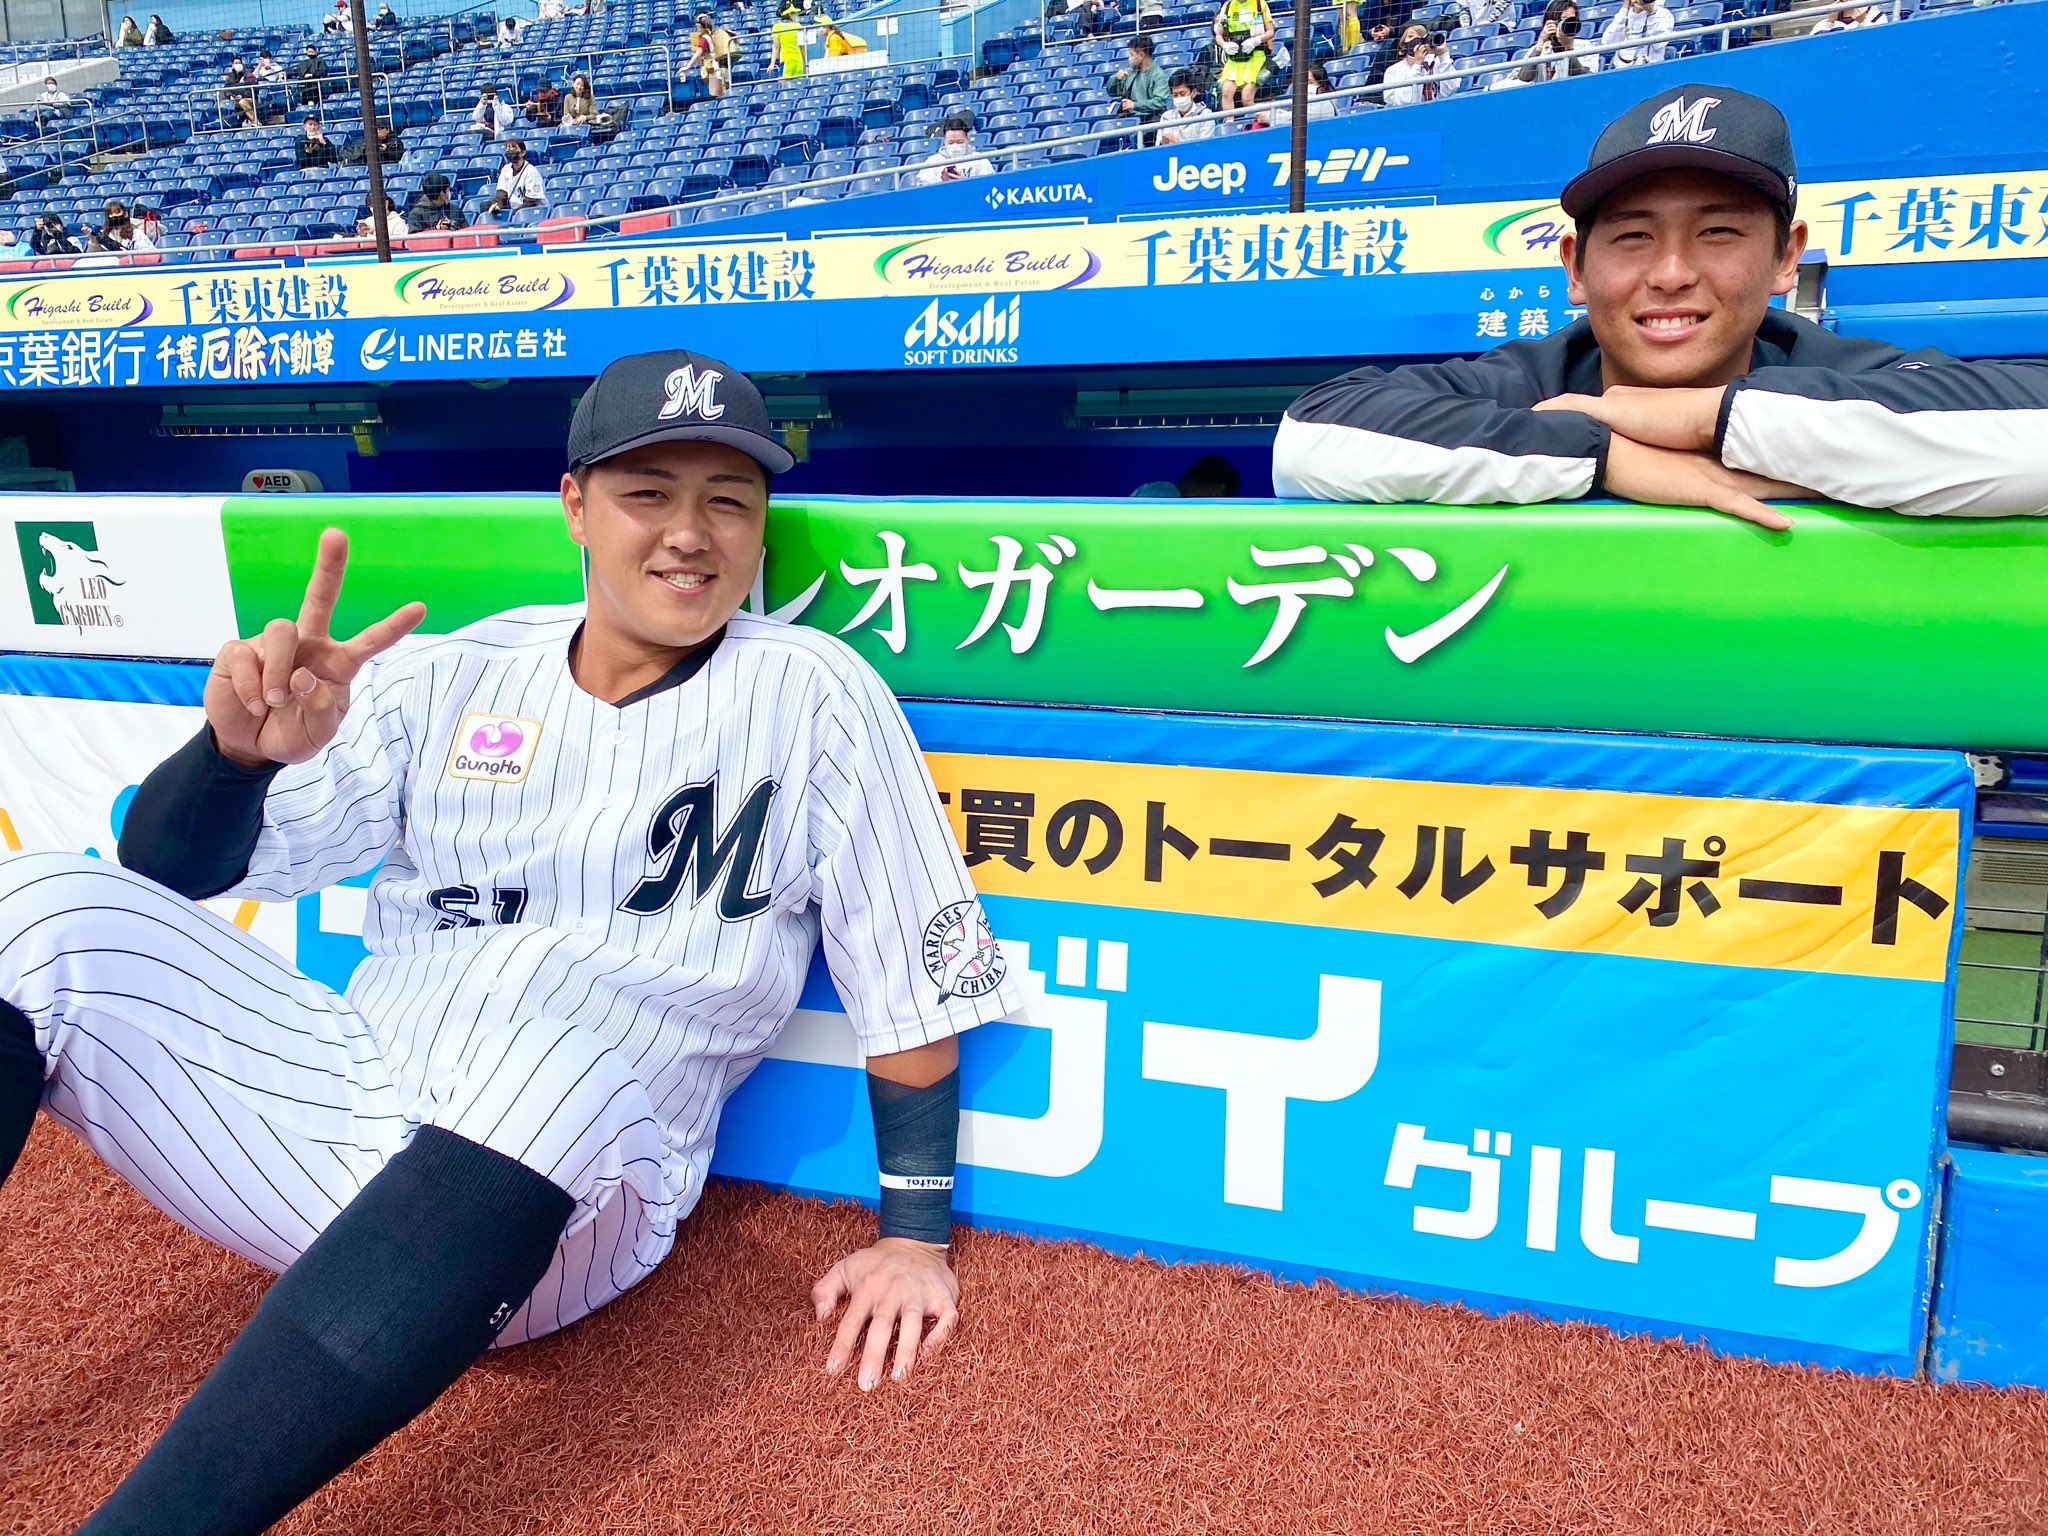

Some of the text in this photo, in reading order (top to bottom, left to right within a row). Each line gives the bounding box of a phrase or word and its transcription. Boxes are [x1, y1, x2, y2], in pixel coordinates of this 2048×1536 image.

[1646, 95, 1723, 145] M
[1006, 183, 1087, 206] KAKUTA
[1152, 156, 1247, 195] Jeep
[903, 250, 1072, 281] Higashi Build
[1126, 217, 1409, 286] 千葉東建設
[169, 274, 350, 325] 千葉東建設
[417, 274, 551, 302] Higashi Build
[594, 249, 817, 307] 千葉東建設
[24, 294, 132, 318] Higashi Build
[903, 293, 1021, 348] Asahi
[155, 325, 336, 381] 千葉厄除不動尊
[904, 347, 1019, 366] SOFT DRINKS
[657, 363, 725, 421] M
[264, 475, 292, 487] AED
[80, 577, 107, 600] LEO
[455, 755, 522, 776] GungHo
[615, 769, 781, 924] M
[937, 789, 1949, 946] 買のトータルサポート
[925, 906, 962, 974] MARINES
[960, 967, 1002, 995] CHIBA
[1383, 1121, 1923, 1290] グループ
